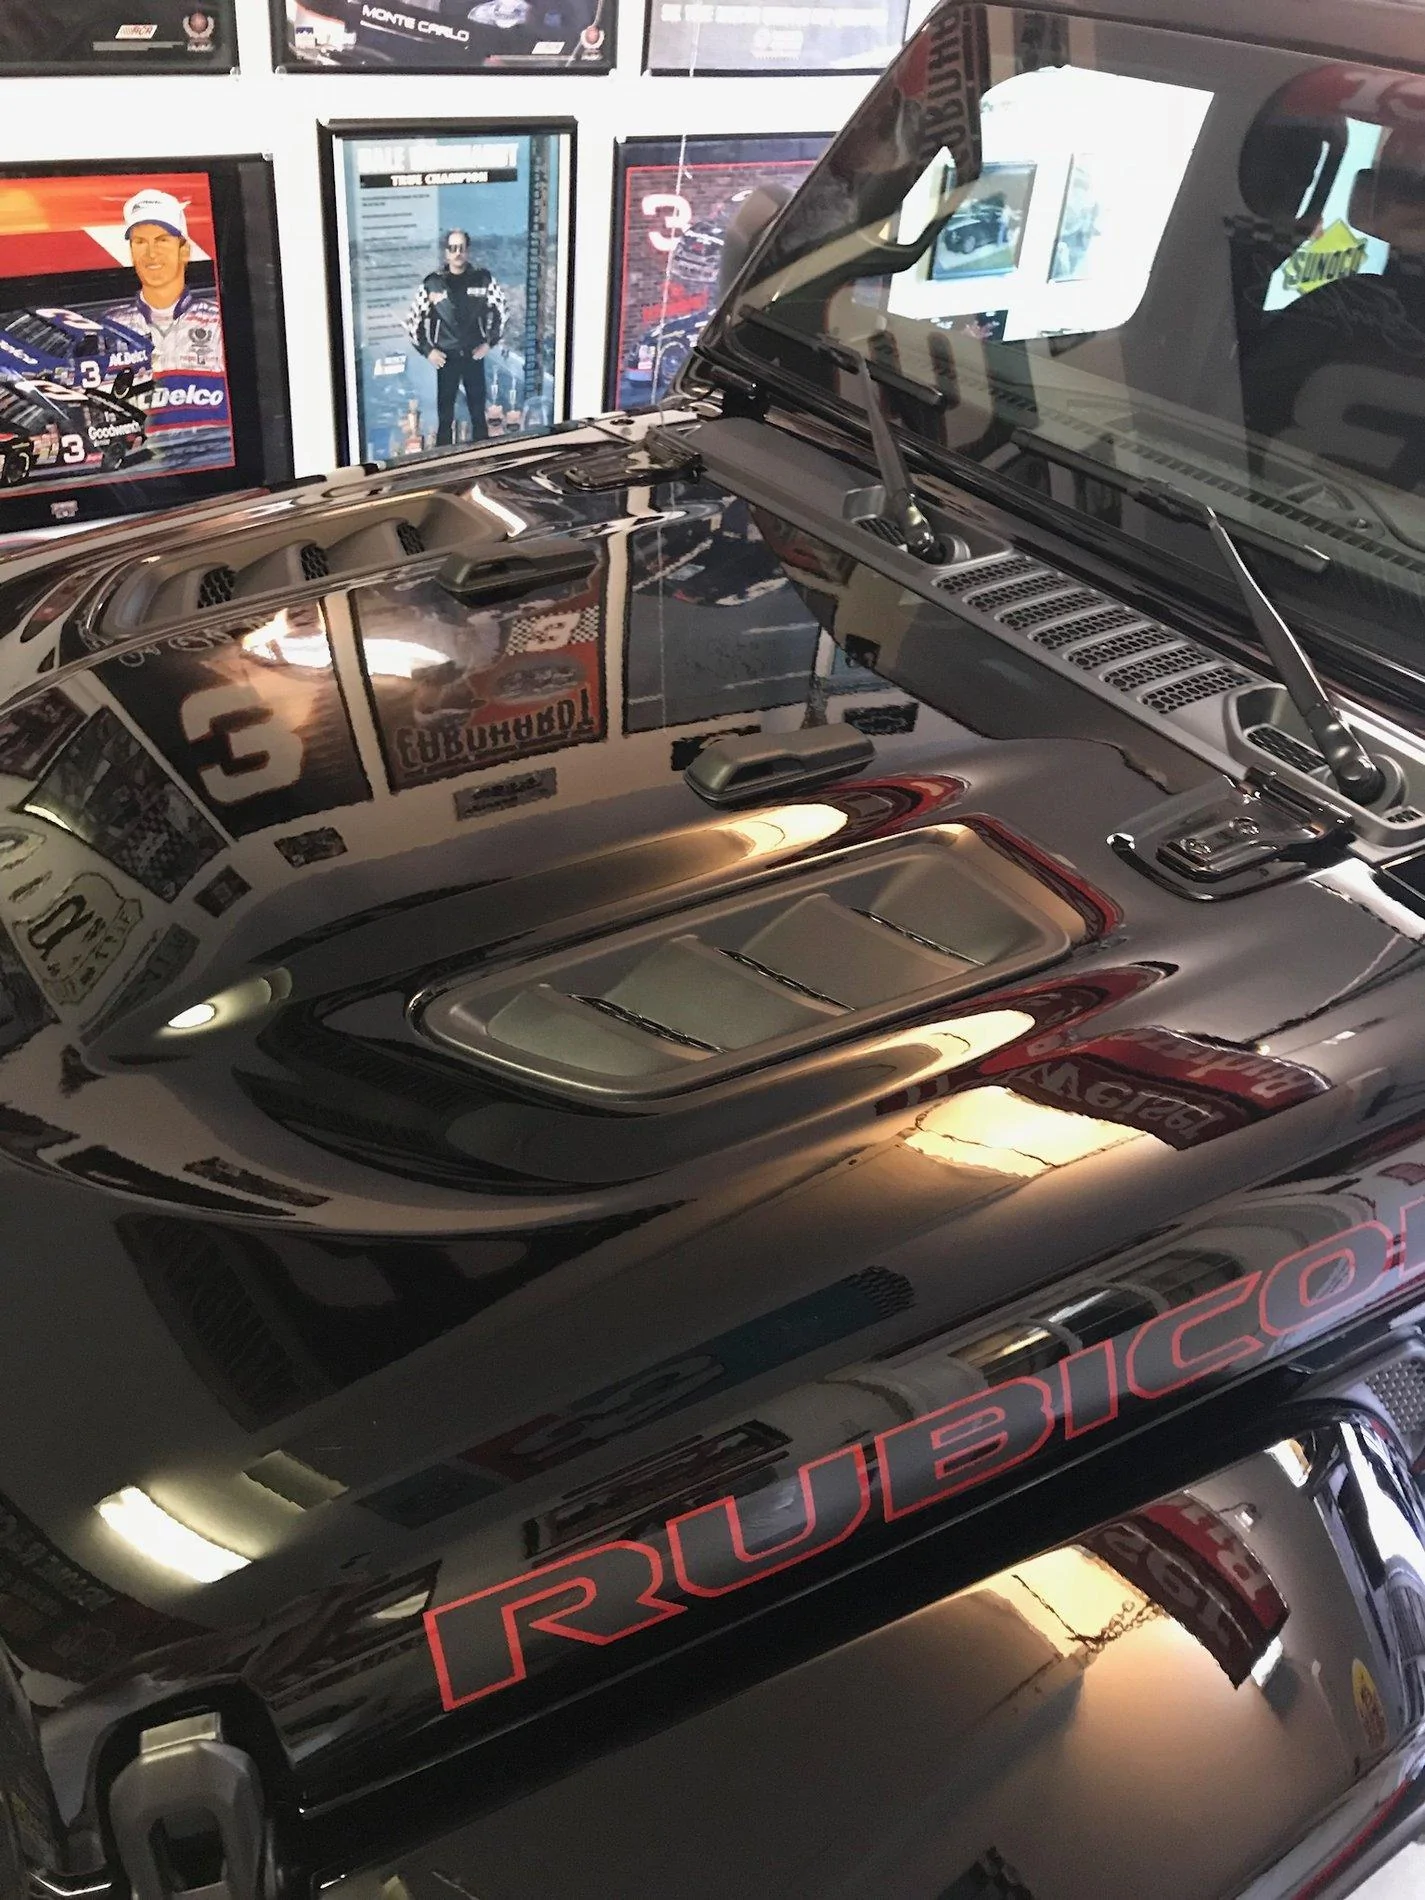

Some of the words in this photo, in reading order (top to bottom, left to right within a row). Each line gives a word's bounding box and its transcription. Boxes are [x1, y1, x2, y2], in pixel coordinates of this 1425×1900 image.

[362, 4, 415, 30] MONTE
[416, 19, 470, 42] CARLO
[390, 174, 423, 187] TRUE
[424, 171, 489, 187] CHAMPION
[641, 194, 693, 251] 3
[80, 360, 101, 389] 3
[136, 384, 224, 411] CDelco
[61, 434, 86, 464] 3
[422, 1195, 1425, 1712] RUBICO
